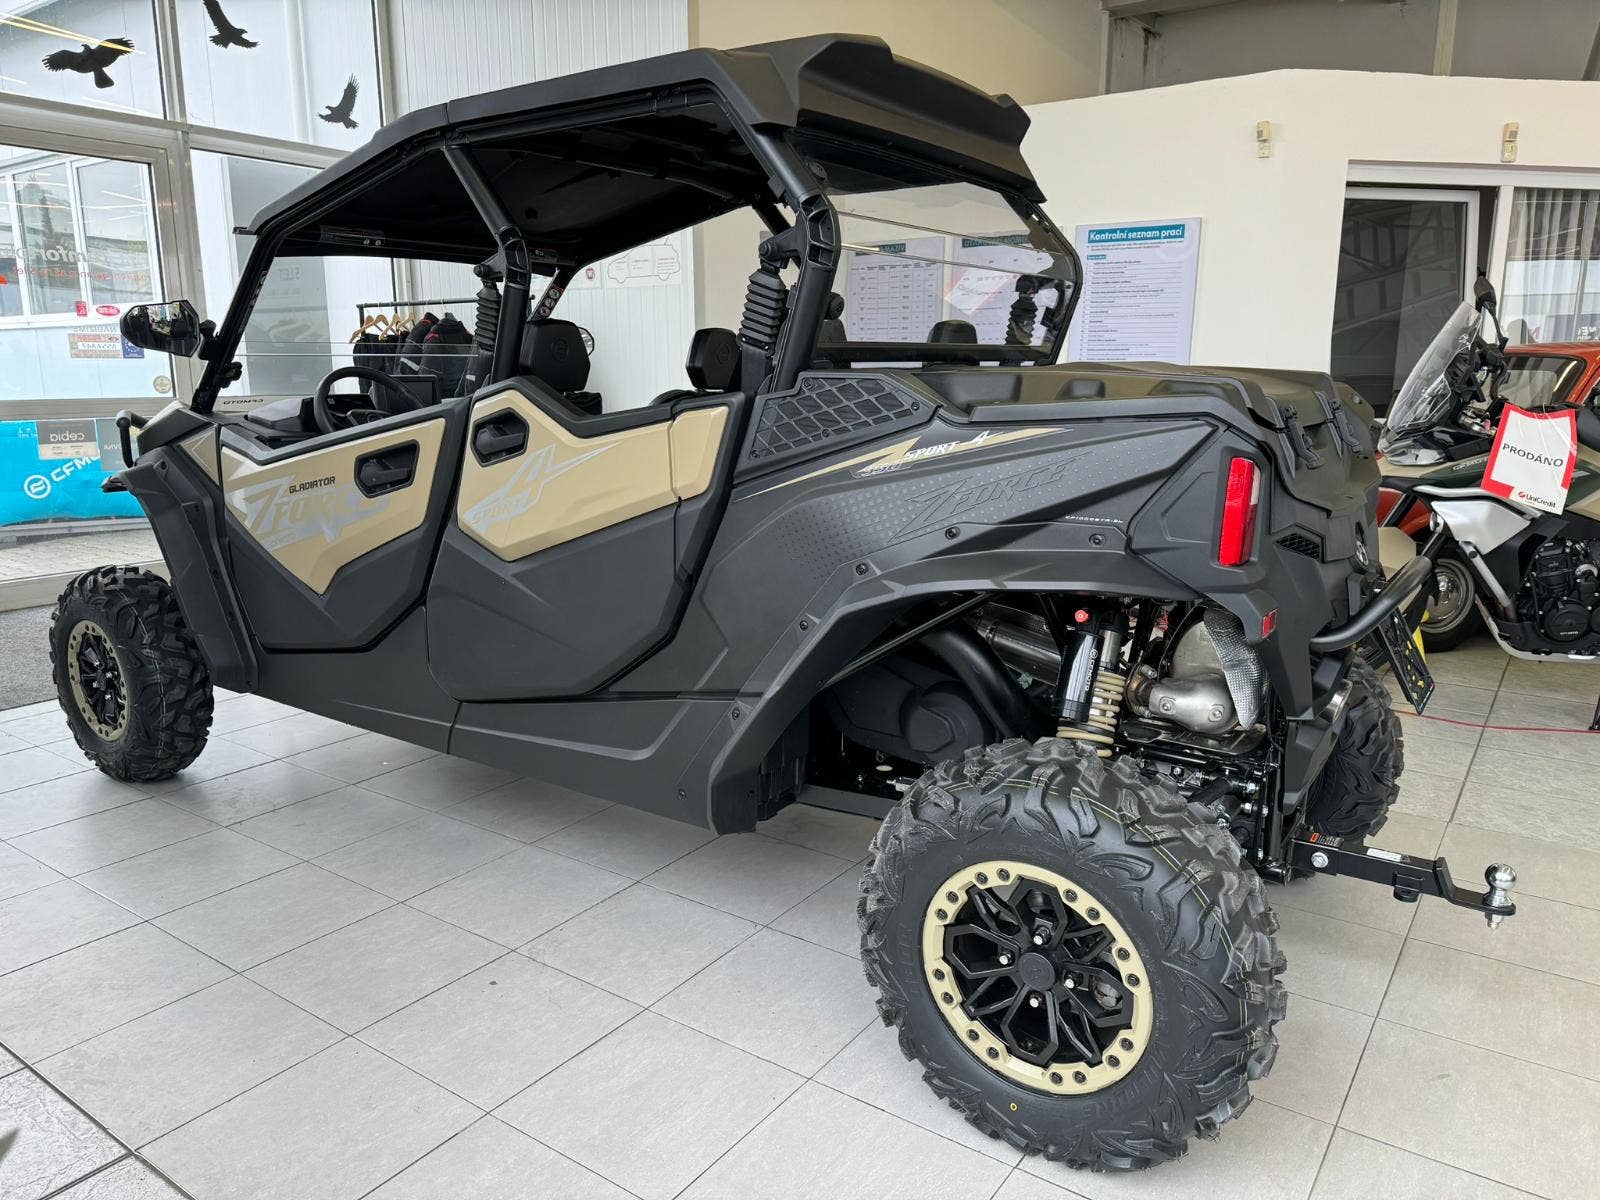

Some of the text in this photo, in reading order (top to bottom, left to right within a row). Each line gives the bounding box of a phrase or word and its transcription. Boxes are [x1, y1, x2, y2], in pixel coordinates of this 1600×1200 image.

[1089, 227, 1183, 241] Kontrolní seznam prací
[903, 441, 960, 460] SPORT
[1503, 443, 1564, 467] PRODÁNO
[50, 455, 100, 482] CFM
[289, 475, 336, 494] GLADIATOR
[1526, 493, 1557, 508] UniCredit
